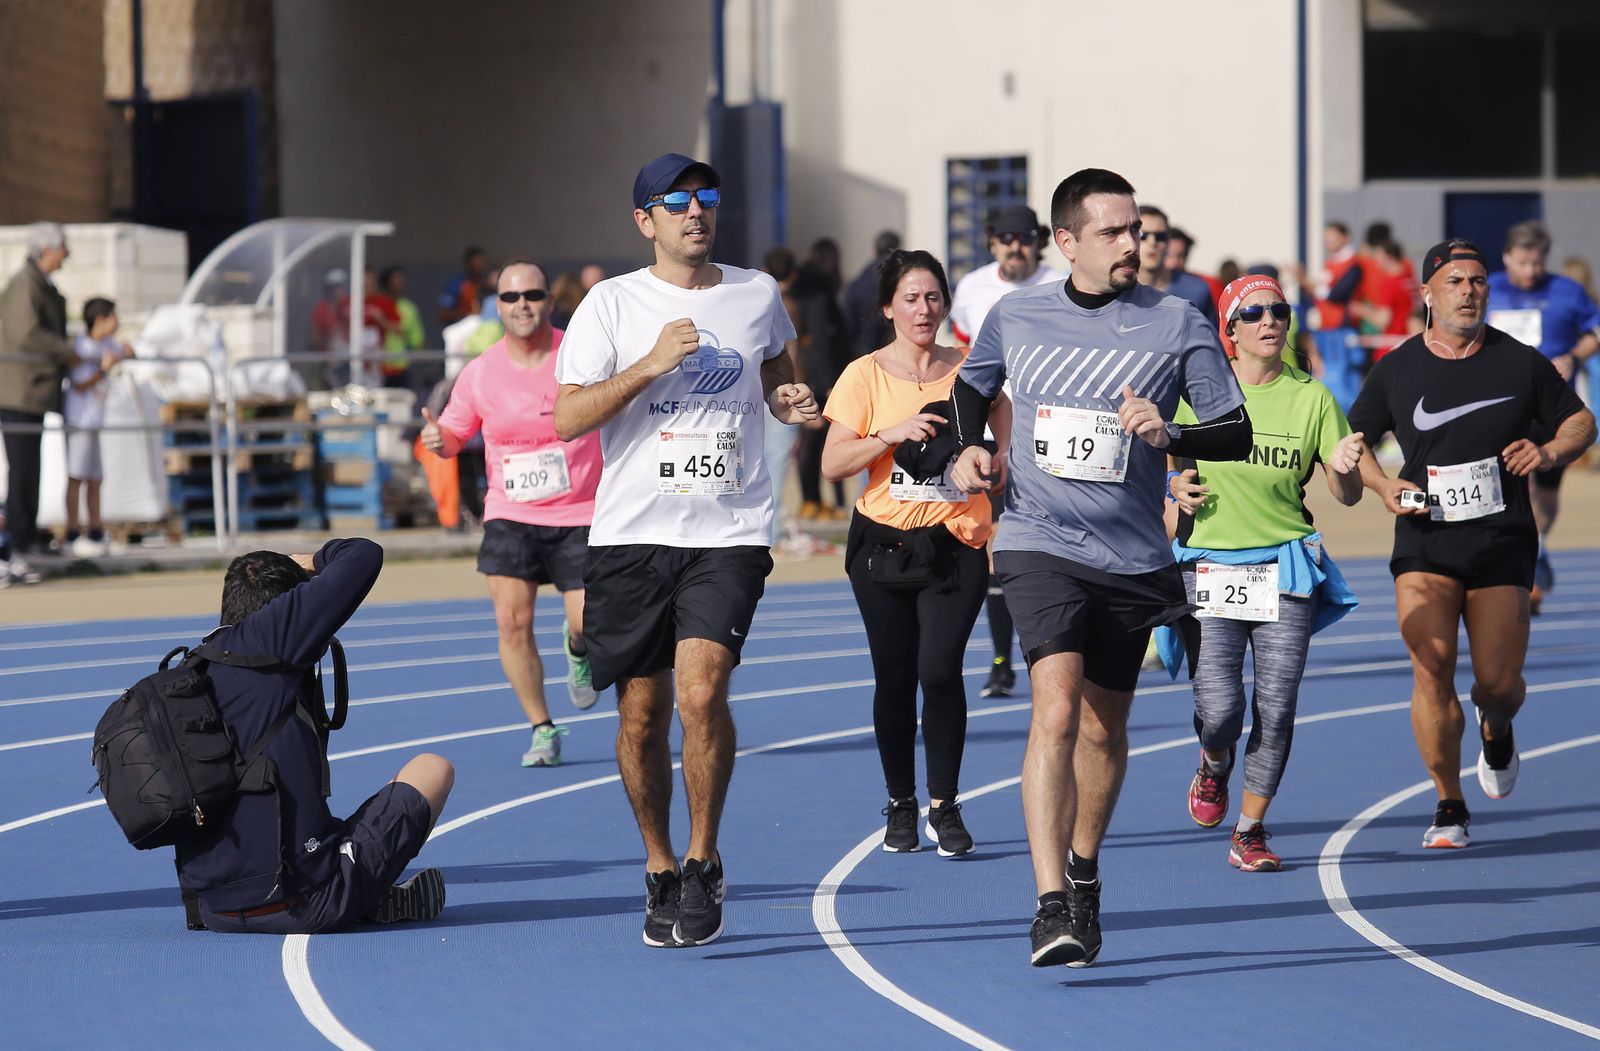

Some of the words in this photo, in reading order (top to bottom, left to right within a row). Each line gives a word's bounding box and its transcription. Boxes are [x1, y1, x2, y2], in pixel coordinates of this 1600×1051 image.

[1066, 436, 1095, 461] 19
[1246, 445, 1302, 471] NCA
[684, 455, 725, 478] 456
[520, 470, 547, 488] 209
[1446, 484, 1482, 506] 314
[1224, 585, 1247, 604] 25
